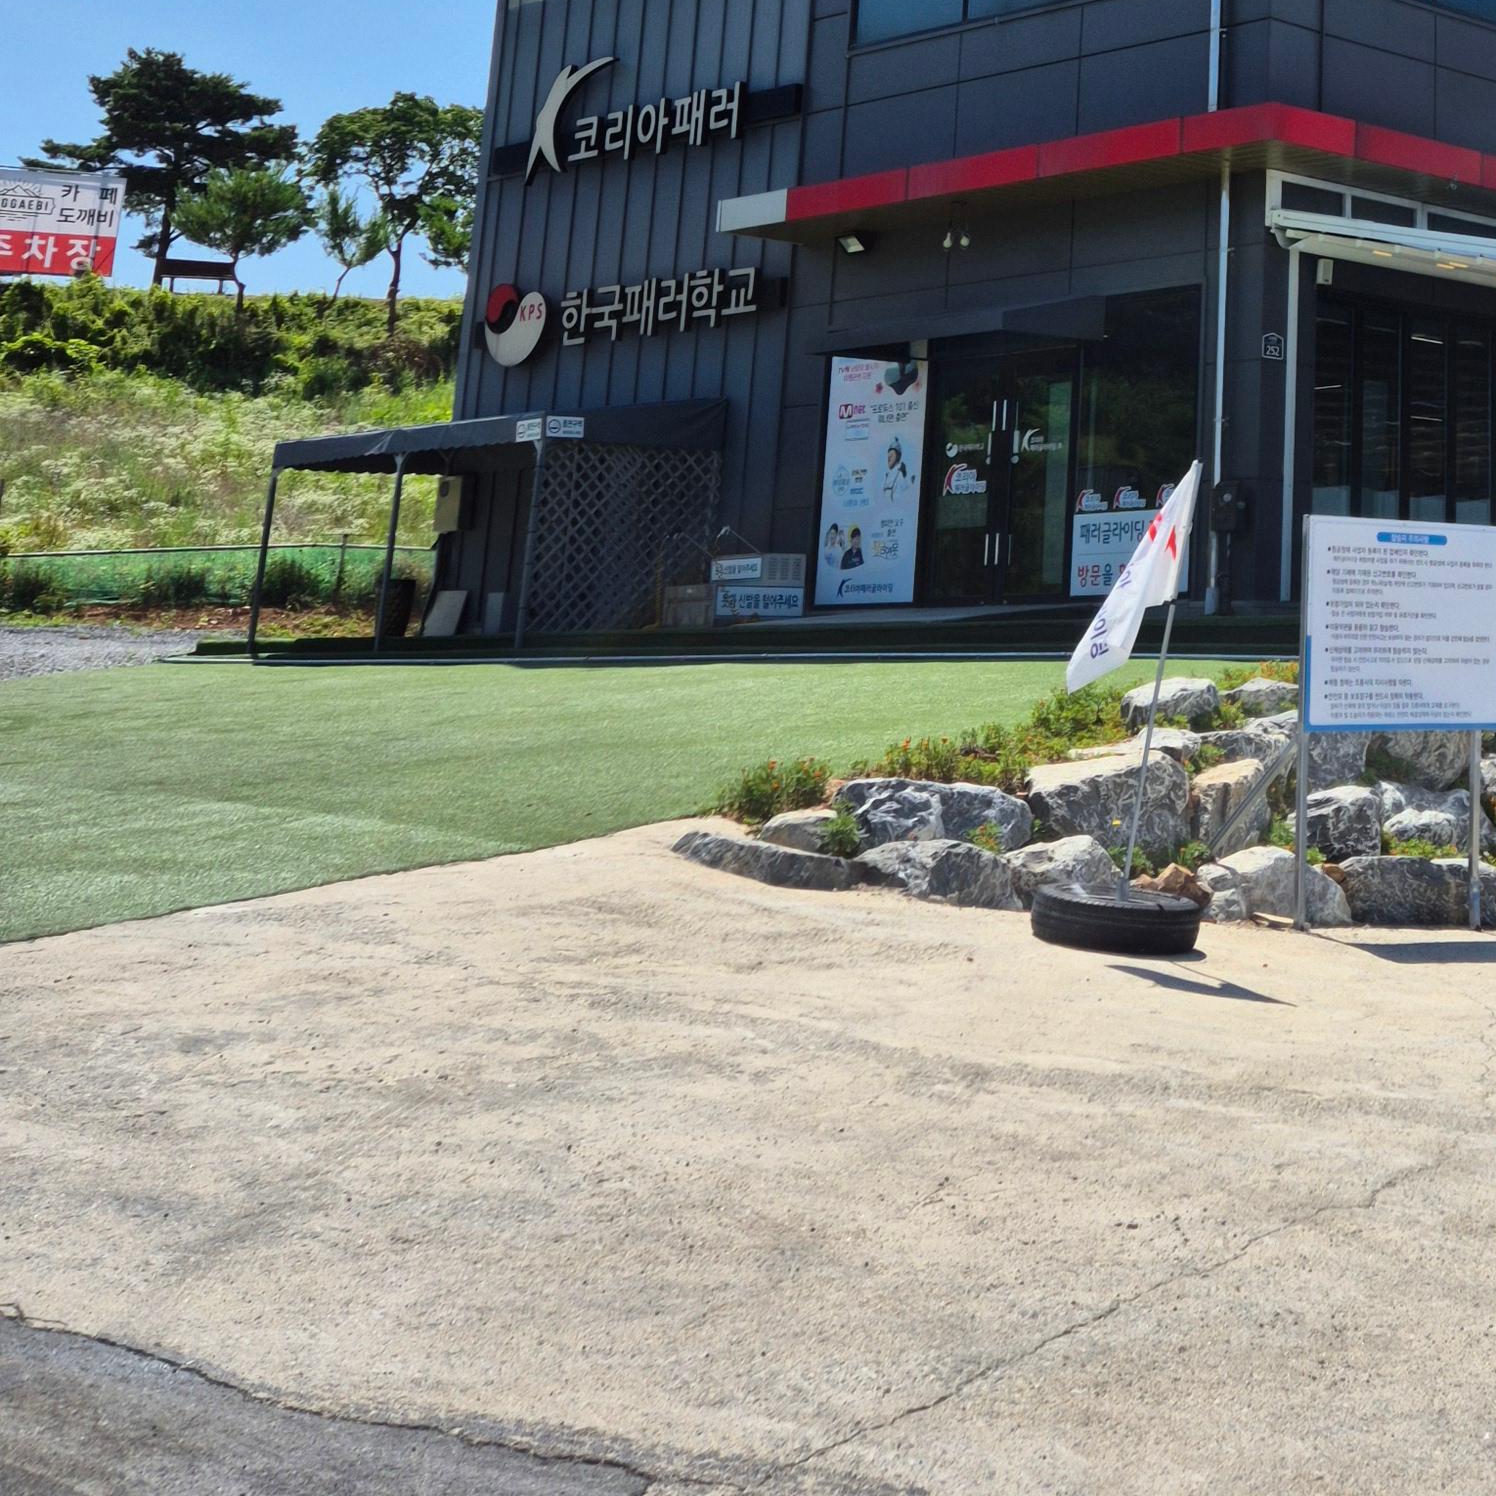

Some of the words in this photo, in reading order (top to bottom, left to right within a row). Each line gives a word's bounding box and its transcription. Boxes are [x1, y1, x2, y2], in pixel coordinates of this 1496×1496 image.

[567, 81, 741, 162] 코리아패러
[56, 207, 114, 228] 도깨비
[519, 302, 543, 322] KPS
[560, 267, 757, 346] 한국패러학교
[1265, 345, 1280, 356] 252
[1079, 519, 1145, 544] 패러글라이딩
[1077, 563, 1114, 588] 방문을
